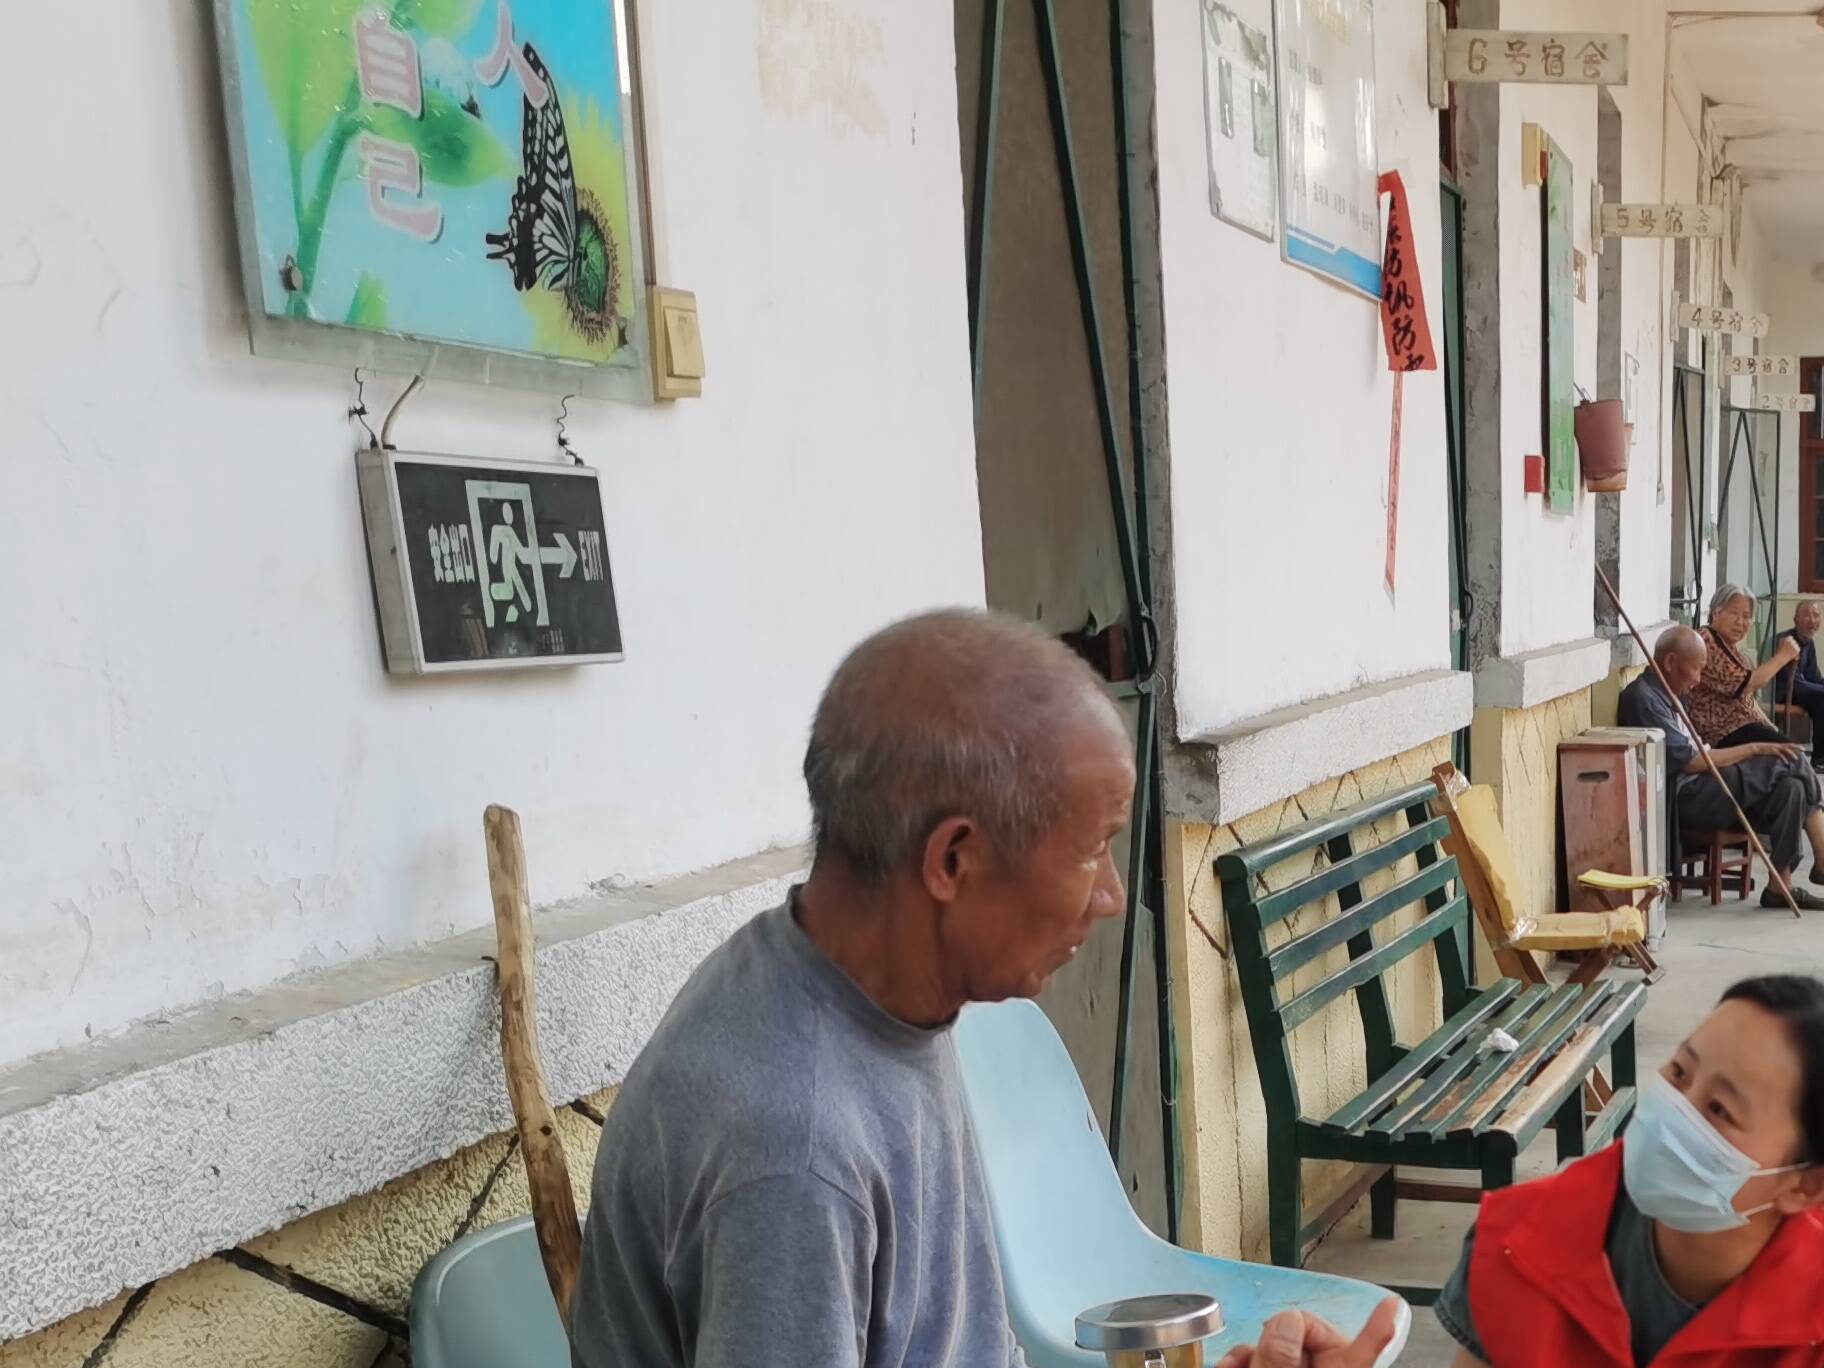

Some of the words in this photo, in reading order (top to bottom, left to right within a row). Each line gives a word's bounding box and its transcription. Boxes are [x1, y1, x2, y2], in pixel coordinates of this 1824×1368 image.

[1467, 38, 1609, 79] 6号宿舍
[1616, 202, 1711, 234] 5号宿舍
[1732, 357, 1790, 375] 3号宿舍
[428, 523, 475, 583] 安全出口
[578, 531, 603, 581] EXIT
